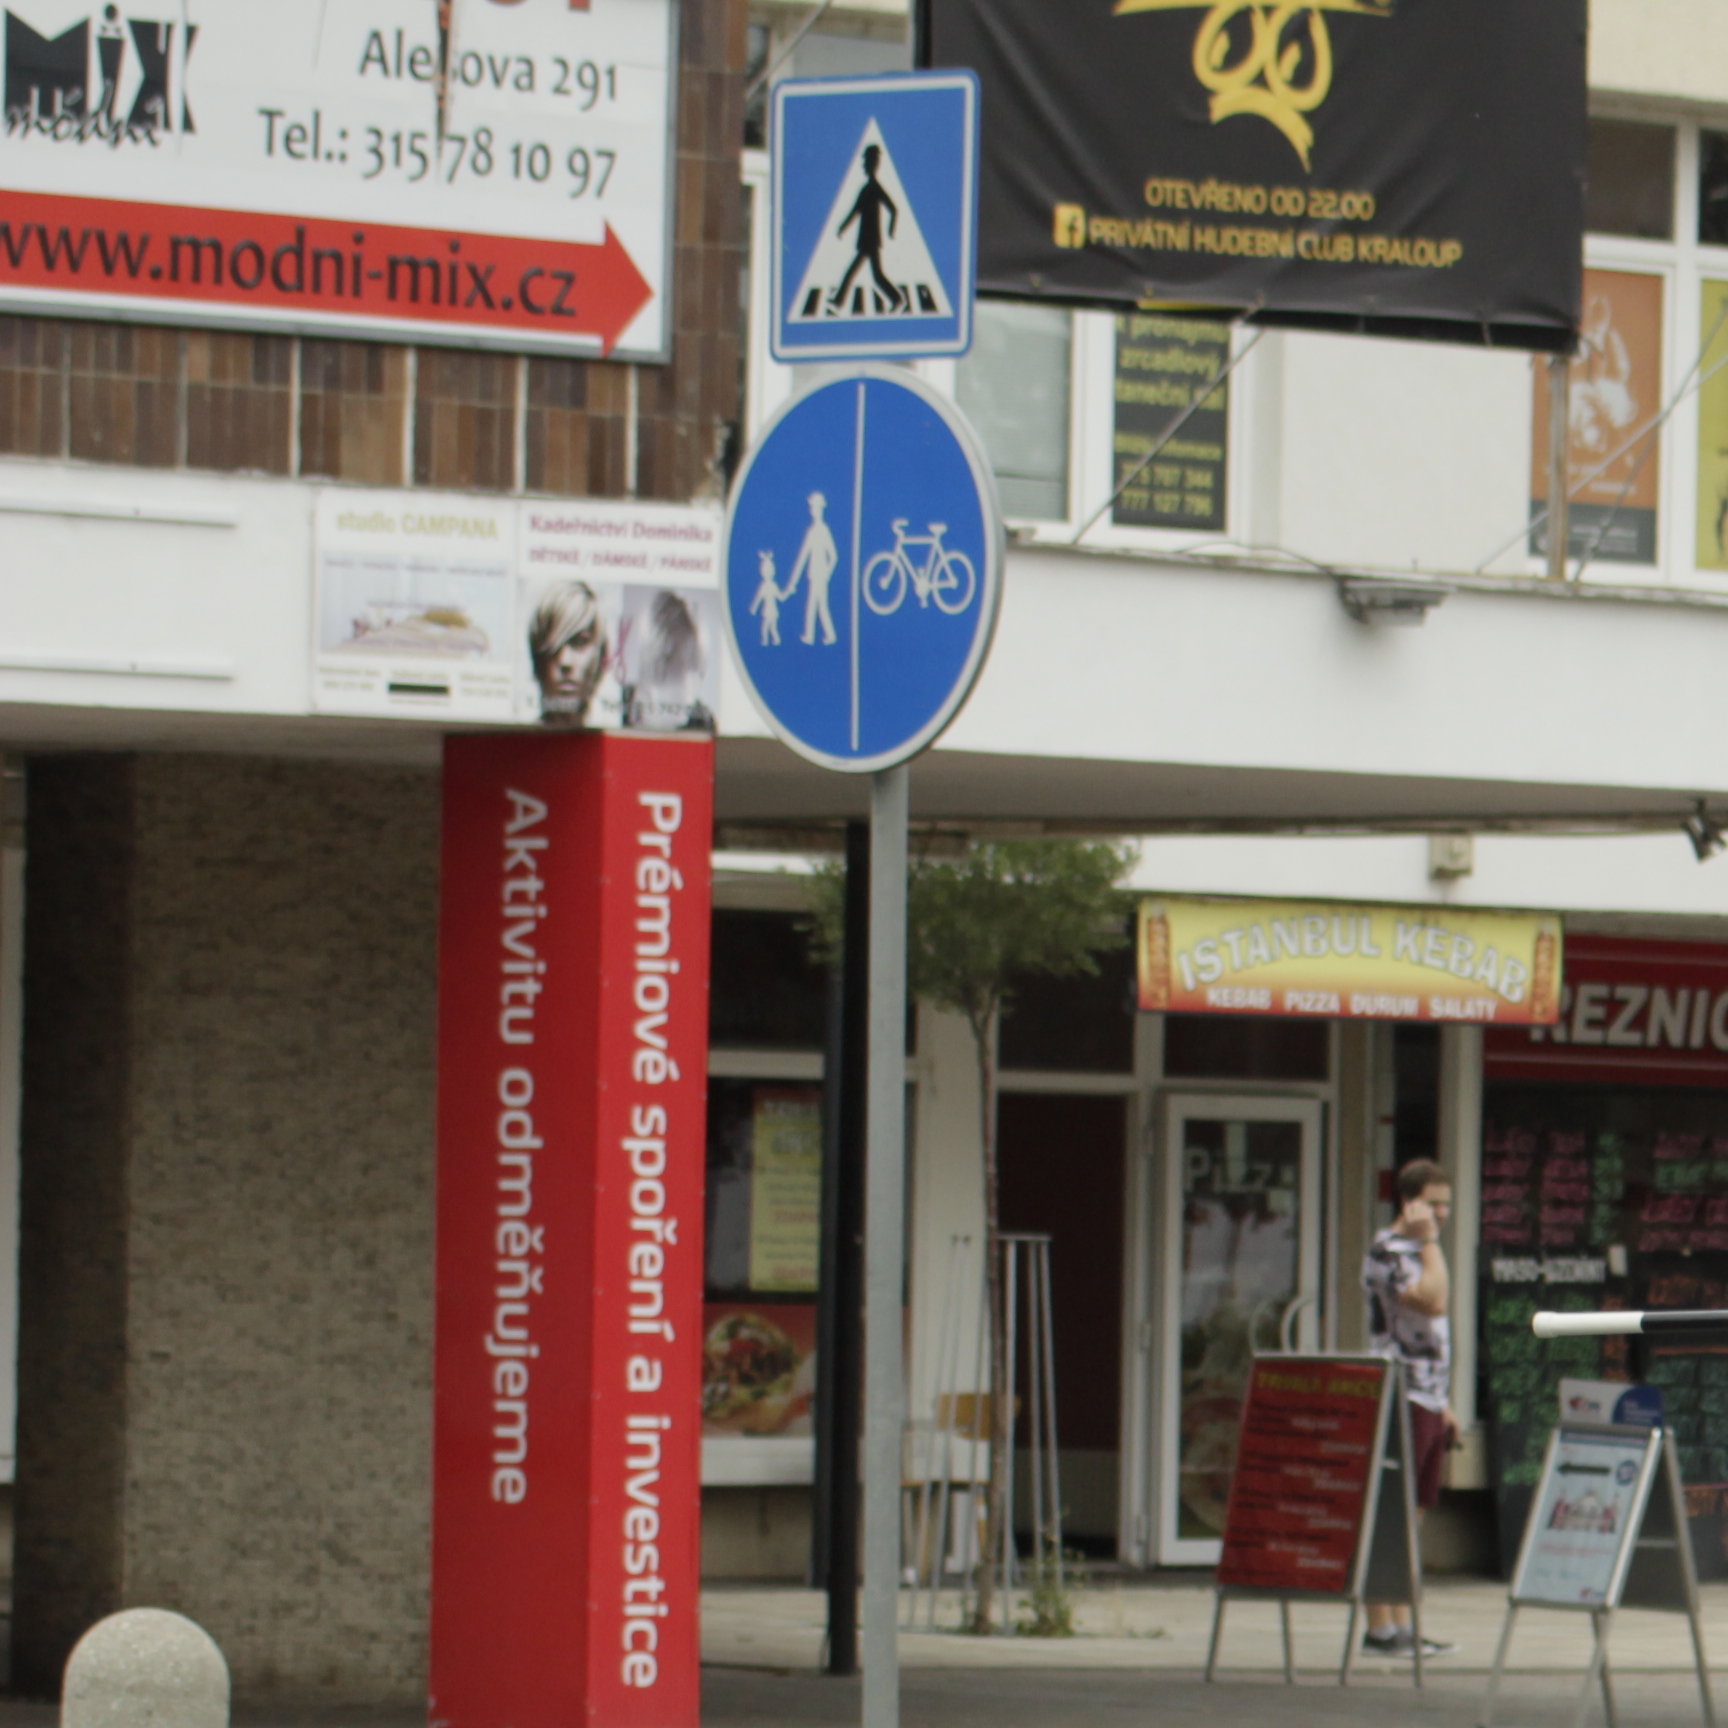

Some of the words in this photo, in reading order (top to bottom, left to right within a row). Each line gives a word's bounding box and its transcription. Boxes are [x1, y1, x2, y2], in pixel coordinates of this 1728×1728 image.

[358, 28, 535, 92] Aleova
[551, 56, 617, 112] 291
[257, 108, 349, 163] Tel.:
[362, 126, 430, 183] 315
[444, 127, 494, 184] 78
[510, 142, 551, 182] 10
[568, 150, 617, 199] 97
[1144, 177, 1266, 215] OTEVŘENO
[1270, 186, 1305, 216] OD
[0, 220, 576, 318] www.modni-mix.cz
[1194, 224, 1295, 259] HUDEBNÍ
[1298, 233, 1354, 263] CLUB
[1358, 235, 1463, 269] KRALOUP
[400, 513, 500, 539] CAMPANA
[497, 788, 550, 1046] Aktivitu
[631, 790, 684, 1085] Prémiové
[1177, 912, 1382, 993] ISTANBUL
[1394, 919, 1530, 1005] KEBAB
[1205, 986, 1273, 1011] KEBAB
[1283, 989, 1341, 1014] PIZZA
[621, 1104, 679, 1343] spoření
[484, 1066, 545, 1504] odměňujeme
[626, 1355, 663, 1393] a
[620, 1414, 671, 1689] investice
